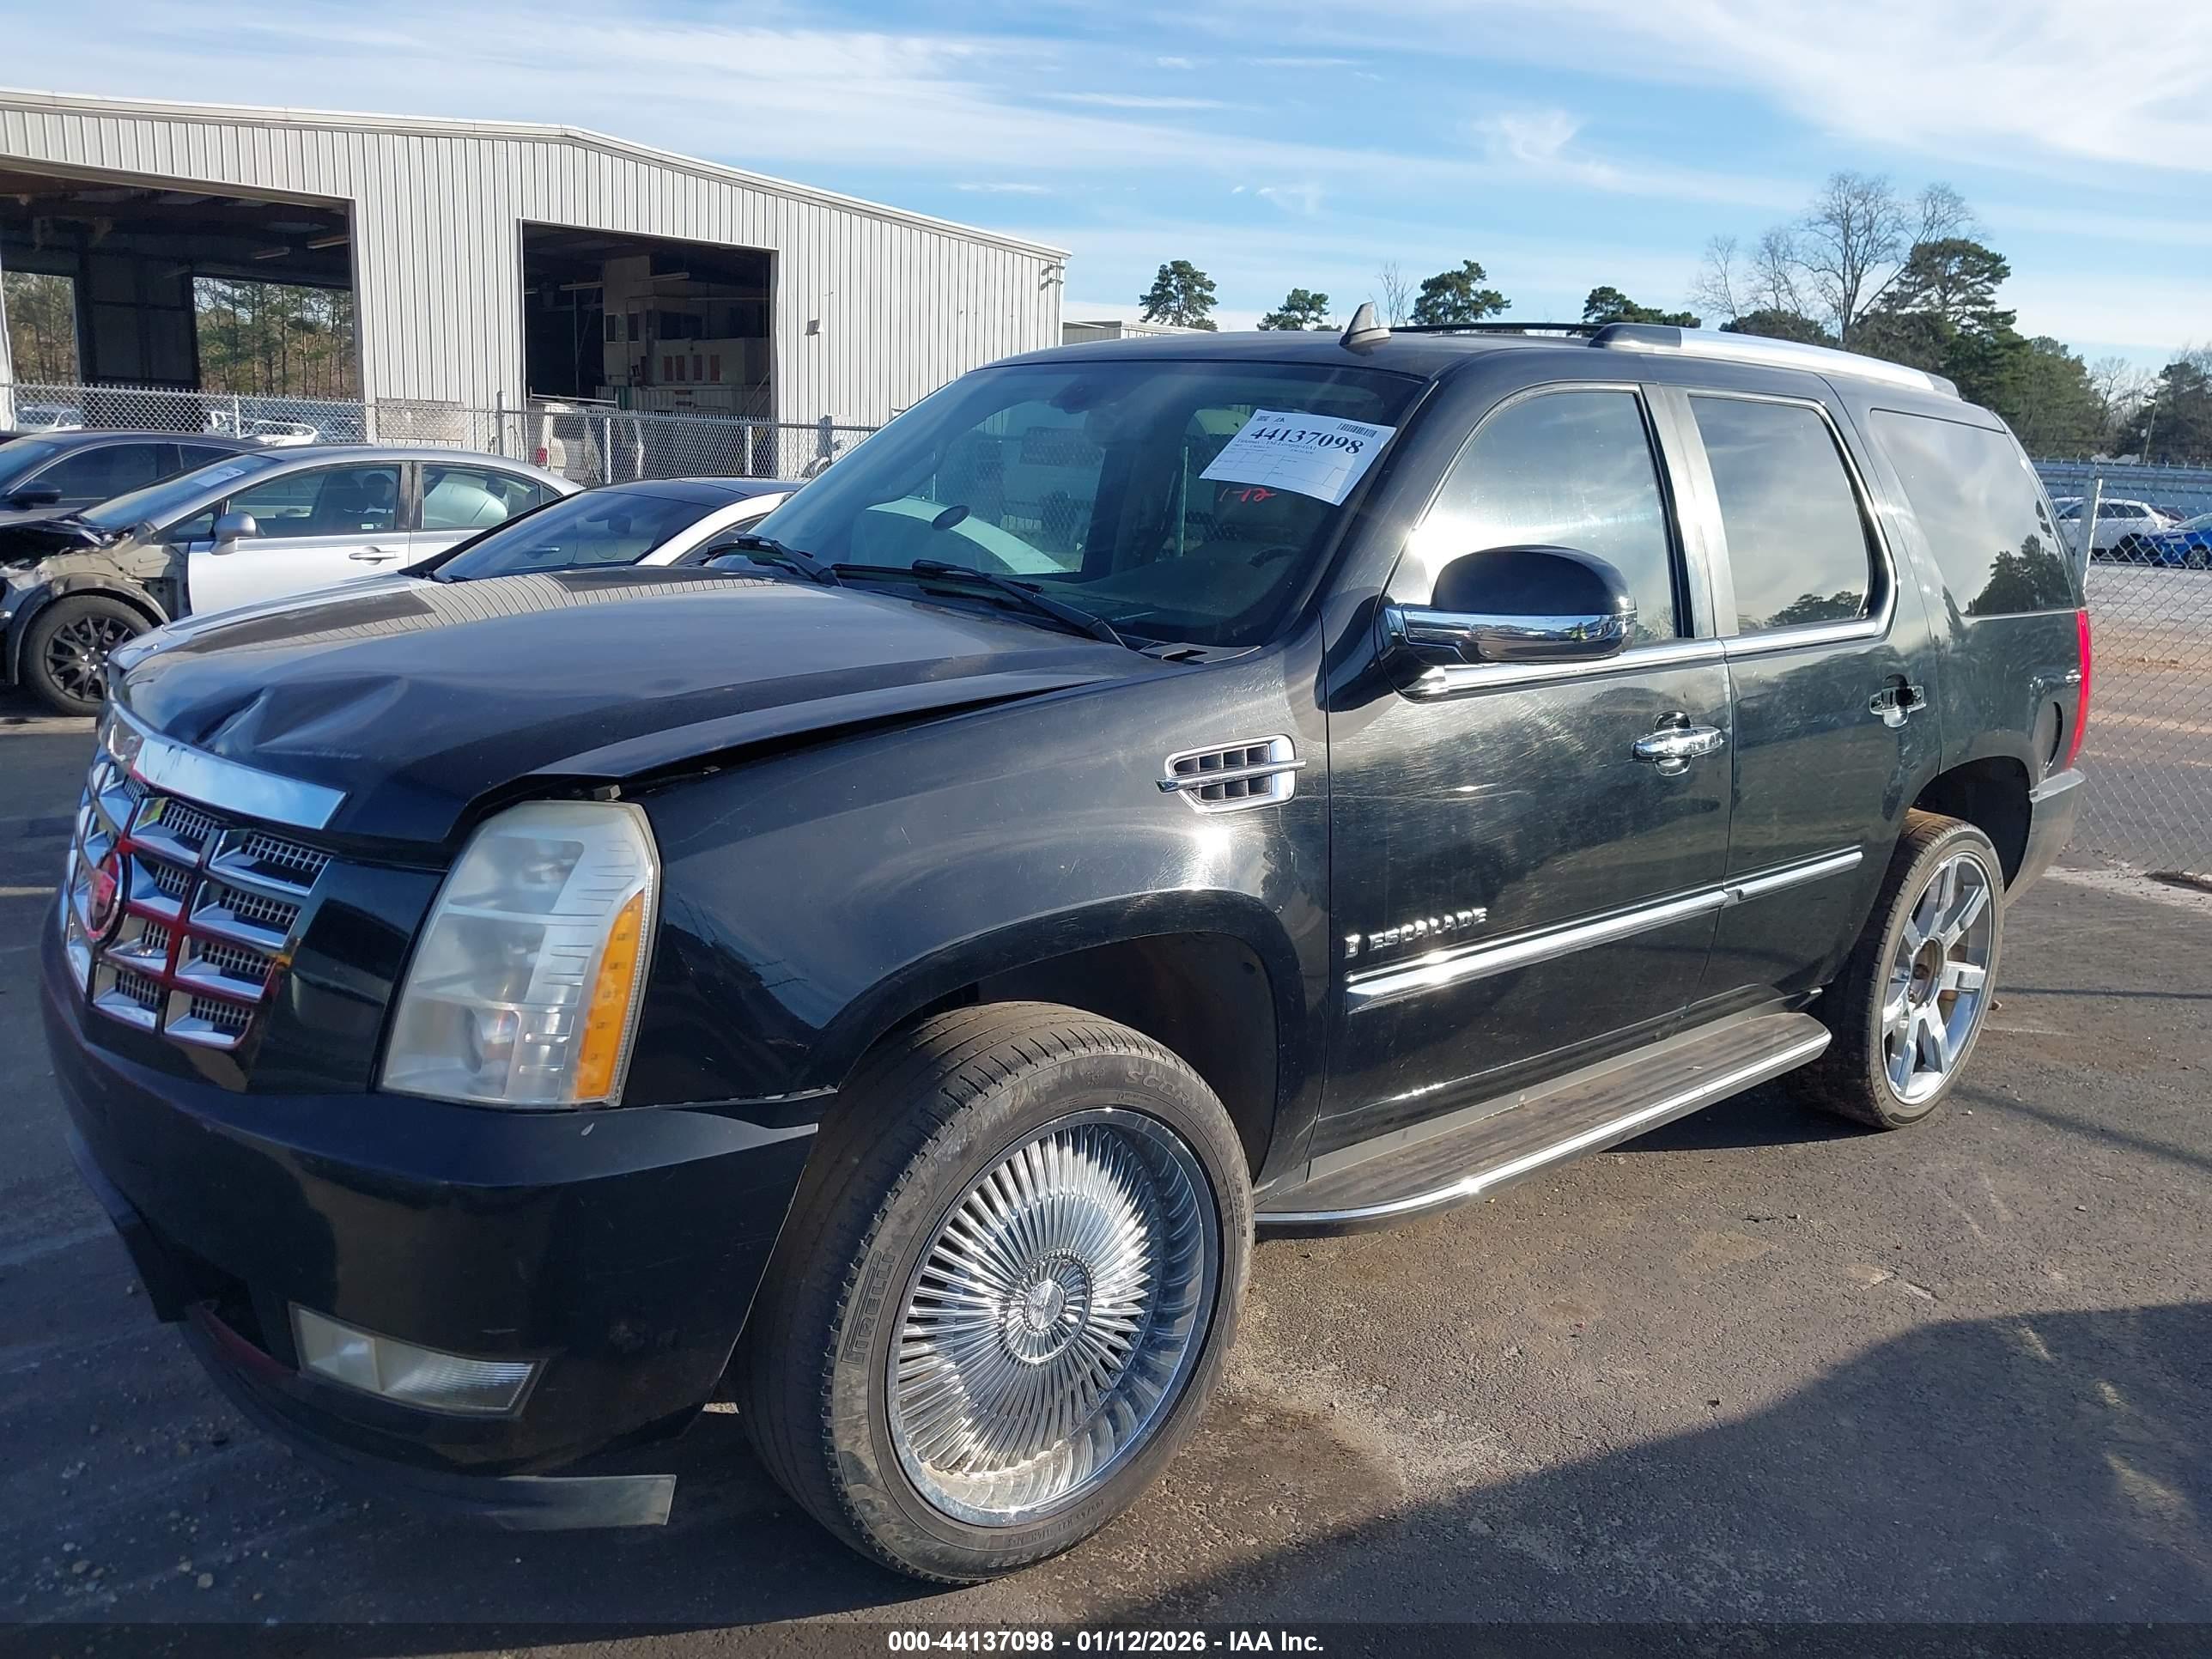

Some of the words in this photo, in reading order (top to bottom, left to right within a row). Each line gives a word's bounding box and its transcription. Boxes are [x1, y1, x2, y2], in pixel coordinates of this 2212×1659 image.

[1250, 427, 1364, 454] 44137098
[1368, 907, 1488, 951] ESCALADE
[841, 1249, 896, 1364] PIRELLI
